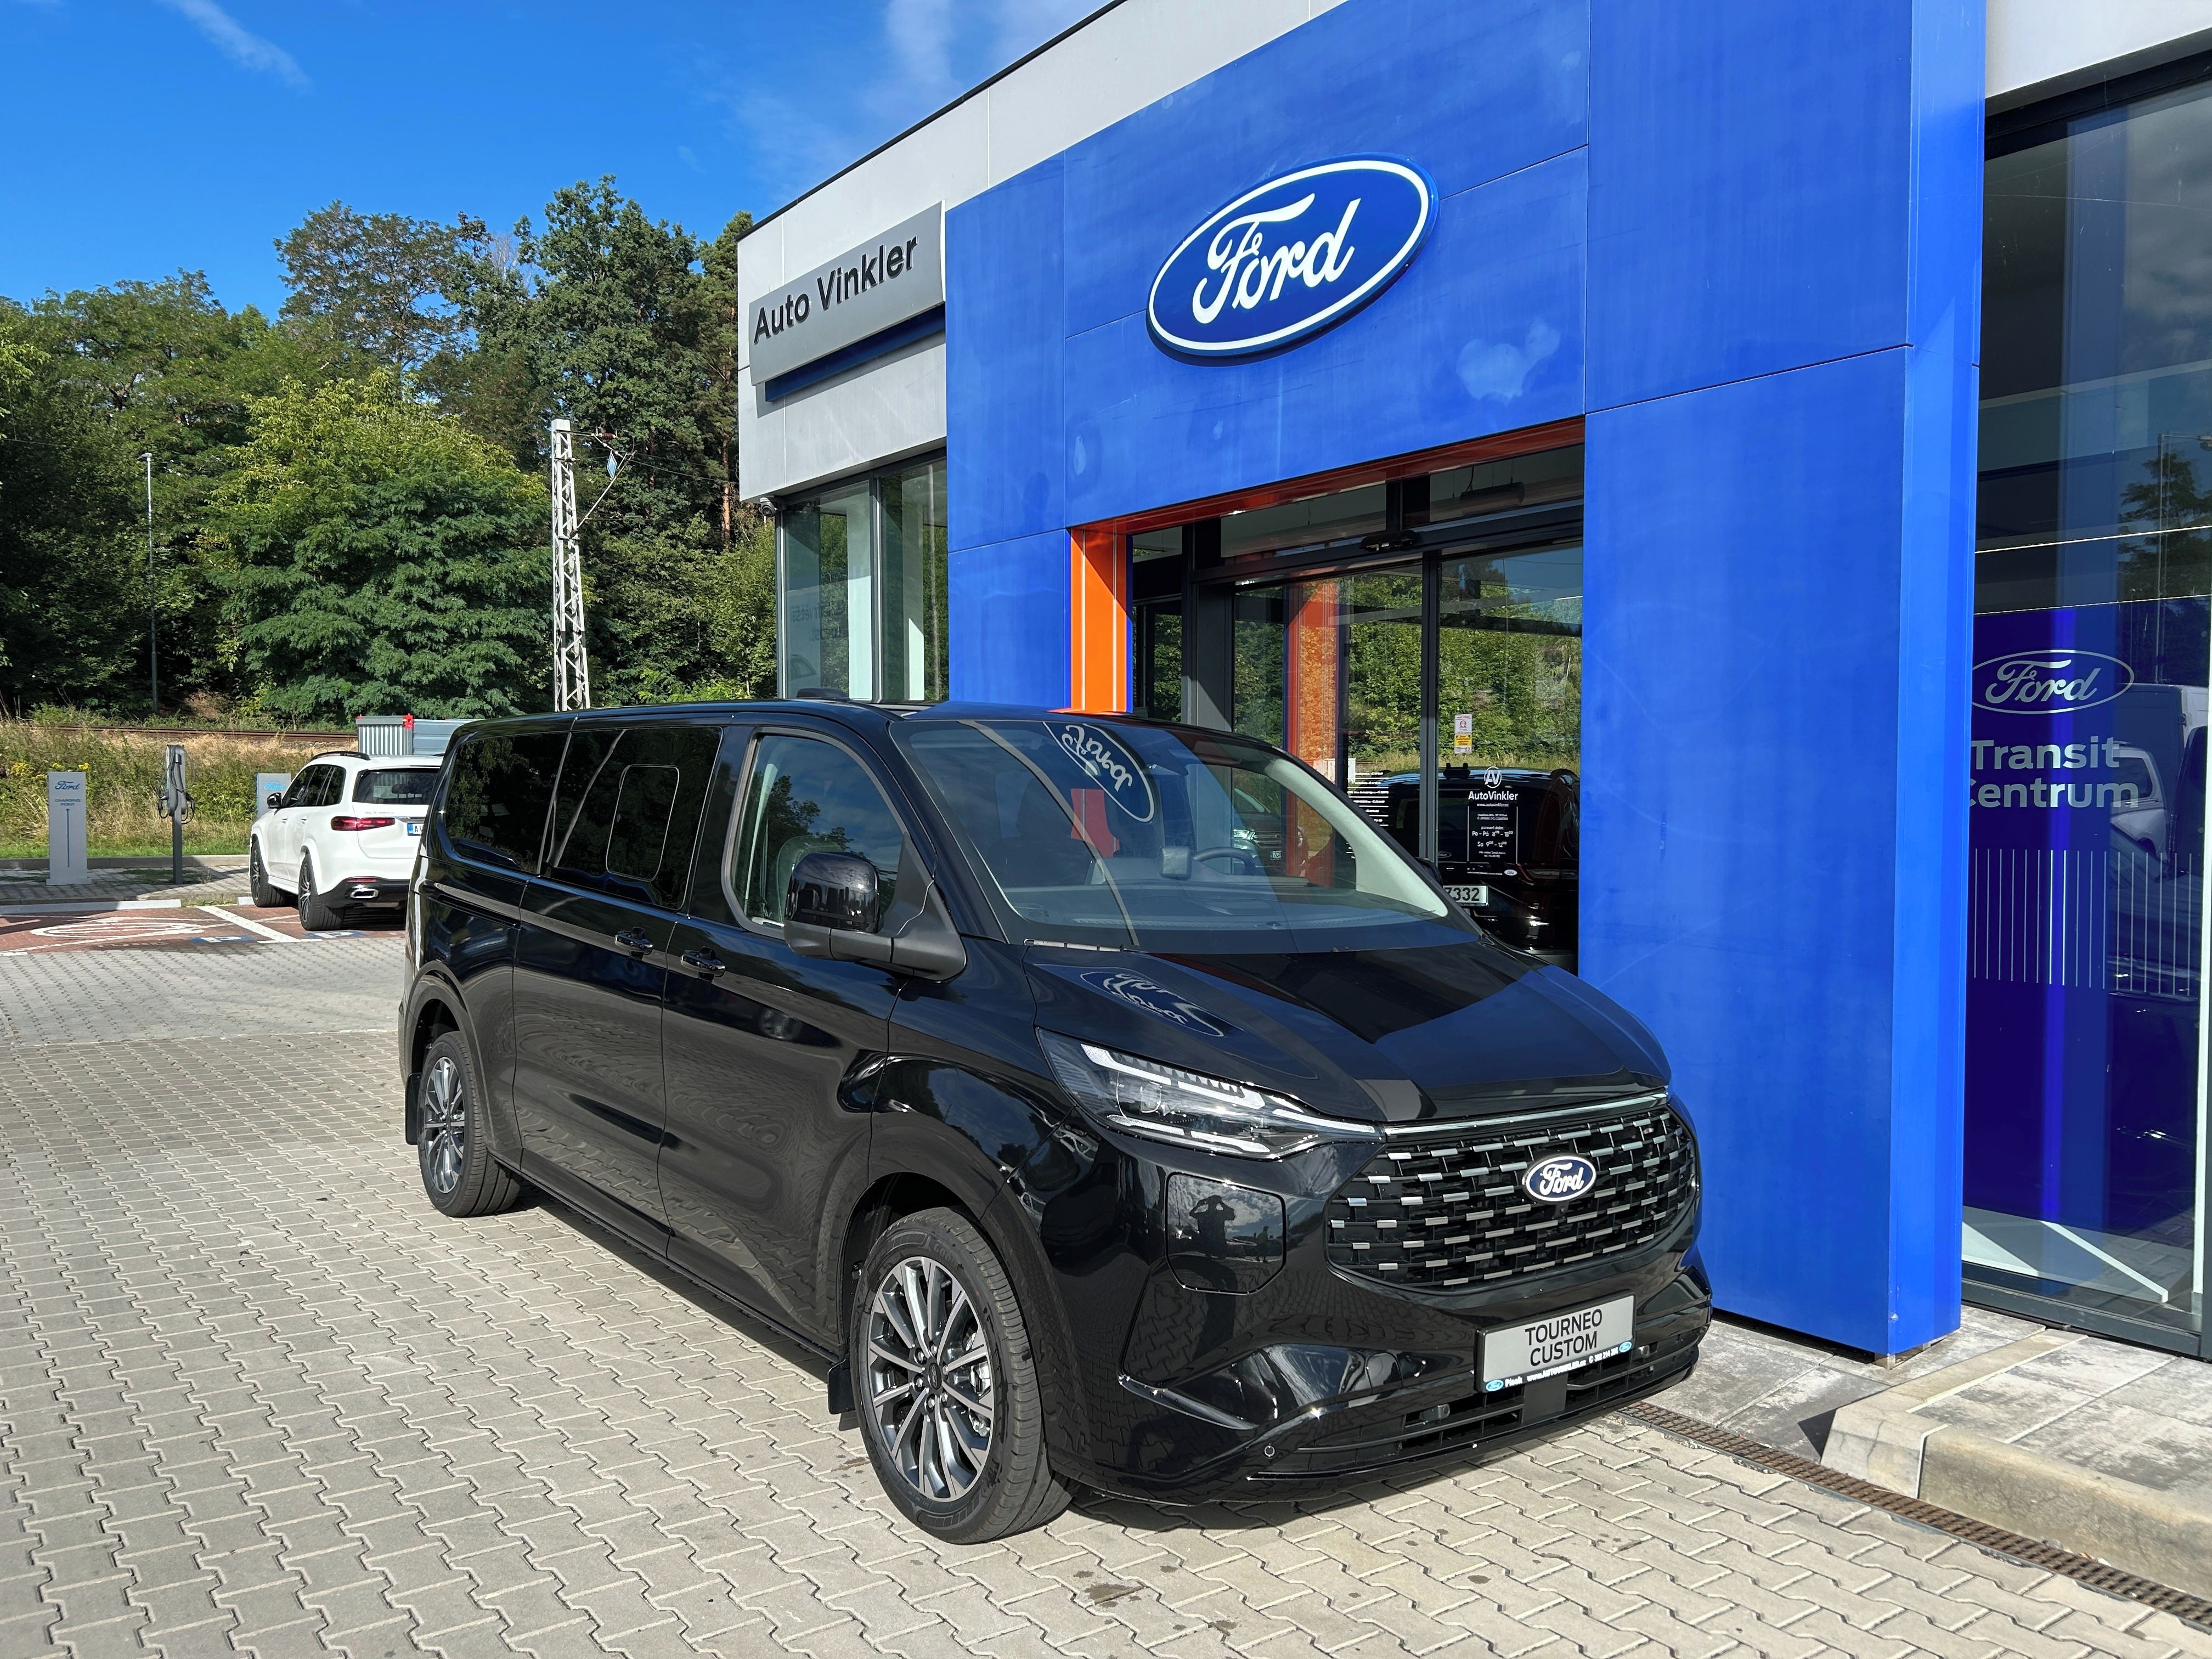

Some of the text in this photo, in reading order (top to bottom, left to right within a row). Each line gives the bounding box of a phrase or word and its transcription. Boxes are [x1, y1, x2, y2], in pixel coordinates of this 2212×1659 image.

[1192, 193, 1361, 324] Ford
[754, 235, 917, 345] Auto Vinkler
[1985, 659, 2101, 704] Ford
[1971, 736, 2120, 770] Transit
[55, 781, 80, 789] Ford
[1468, 791, 1518, 800] AutoVinkler
[1970, 778, 2138, 808] entrum
[1540, 1163, 1584, 1195] Ford
[1525, 1309, 1602, 1346] TOURNEO
[1531, 1331, 1597, 1366] CUSTOM
